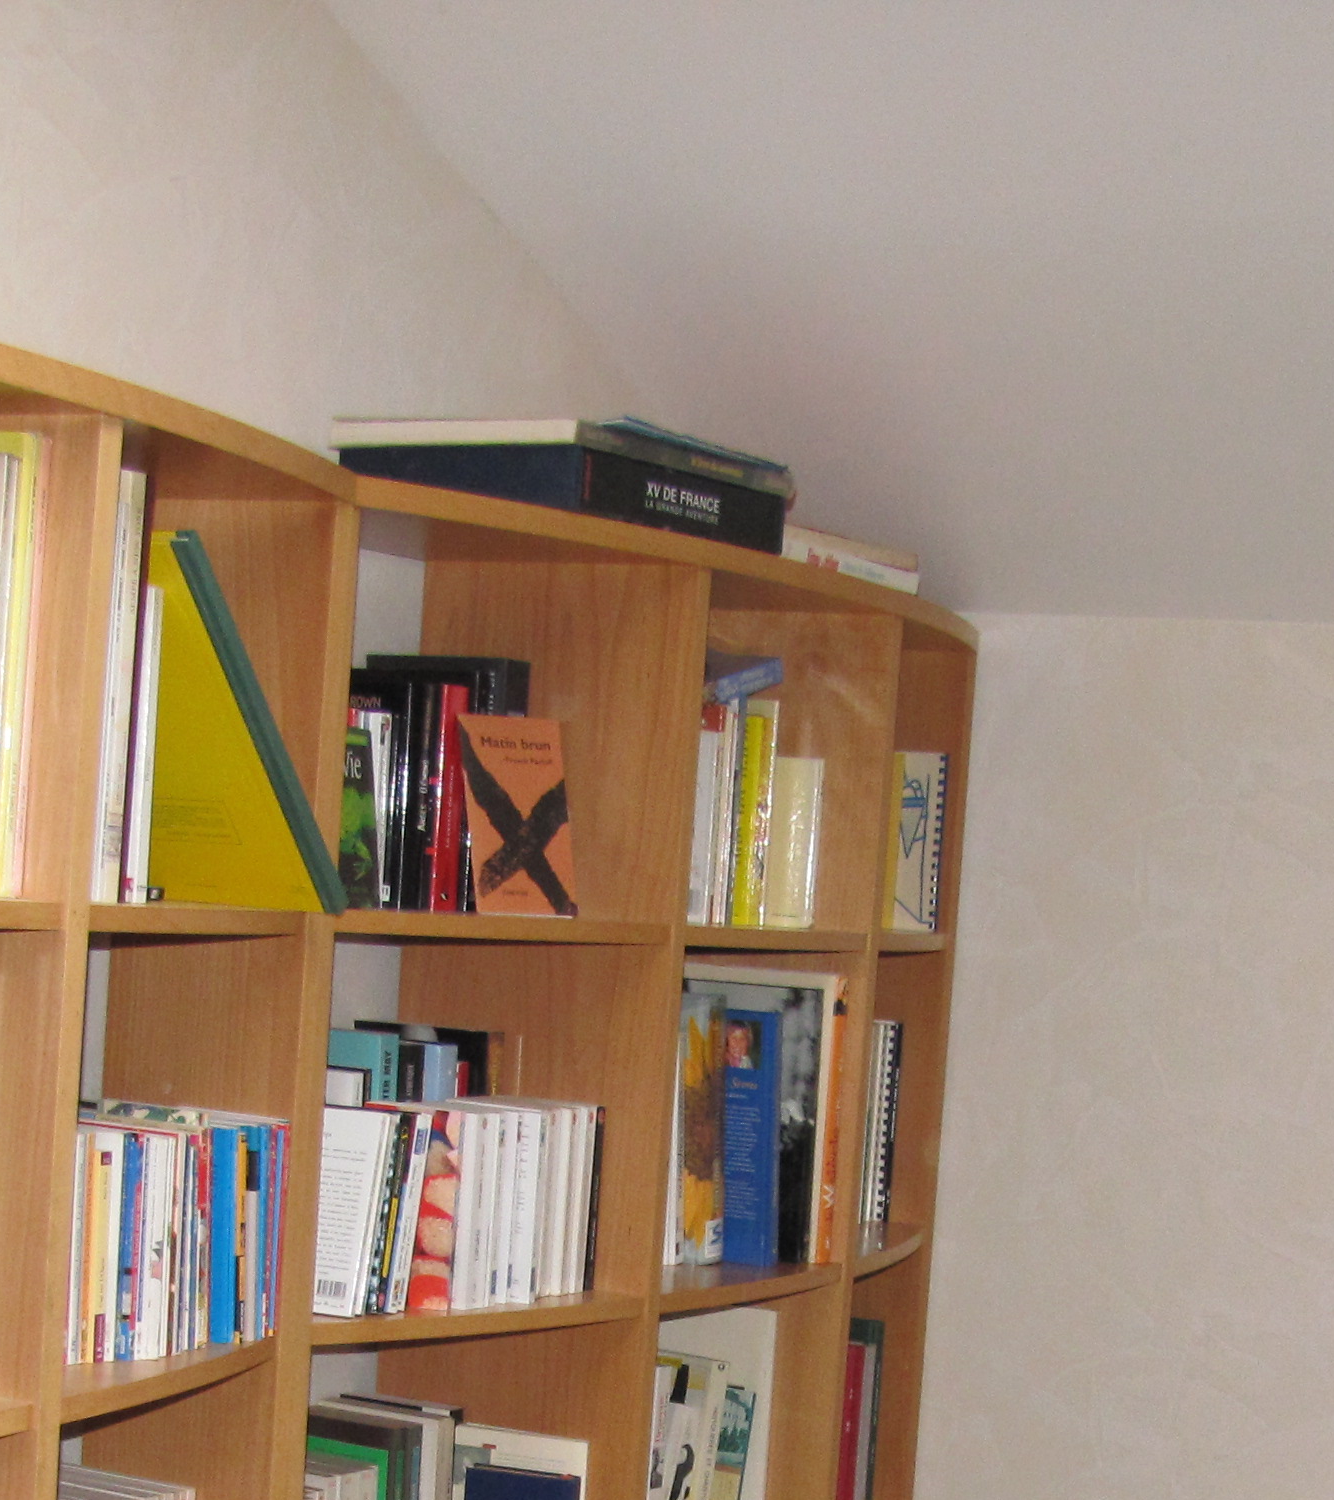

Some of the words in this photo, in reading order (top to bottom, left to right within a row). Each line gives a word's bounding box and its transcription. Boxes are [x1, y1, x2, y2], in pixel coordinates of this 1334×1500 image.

[647, 481, 661, 501] XV
[661, 484, 677, 503] DE
[679, 486, 719, 514] FRANCE
[481, 736, 517, 750] Matin
[521, 738, 551, 751] brun
